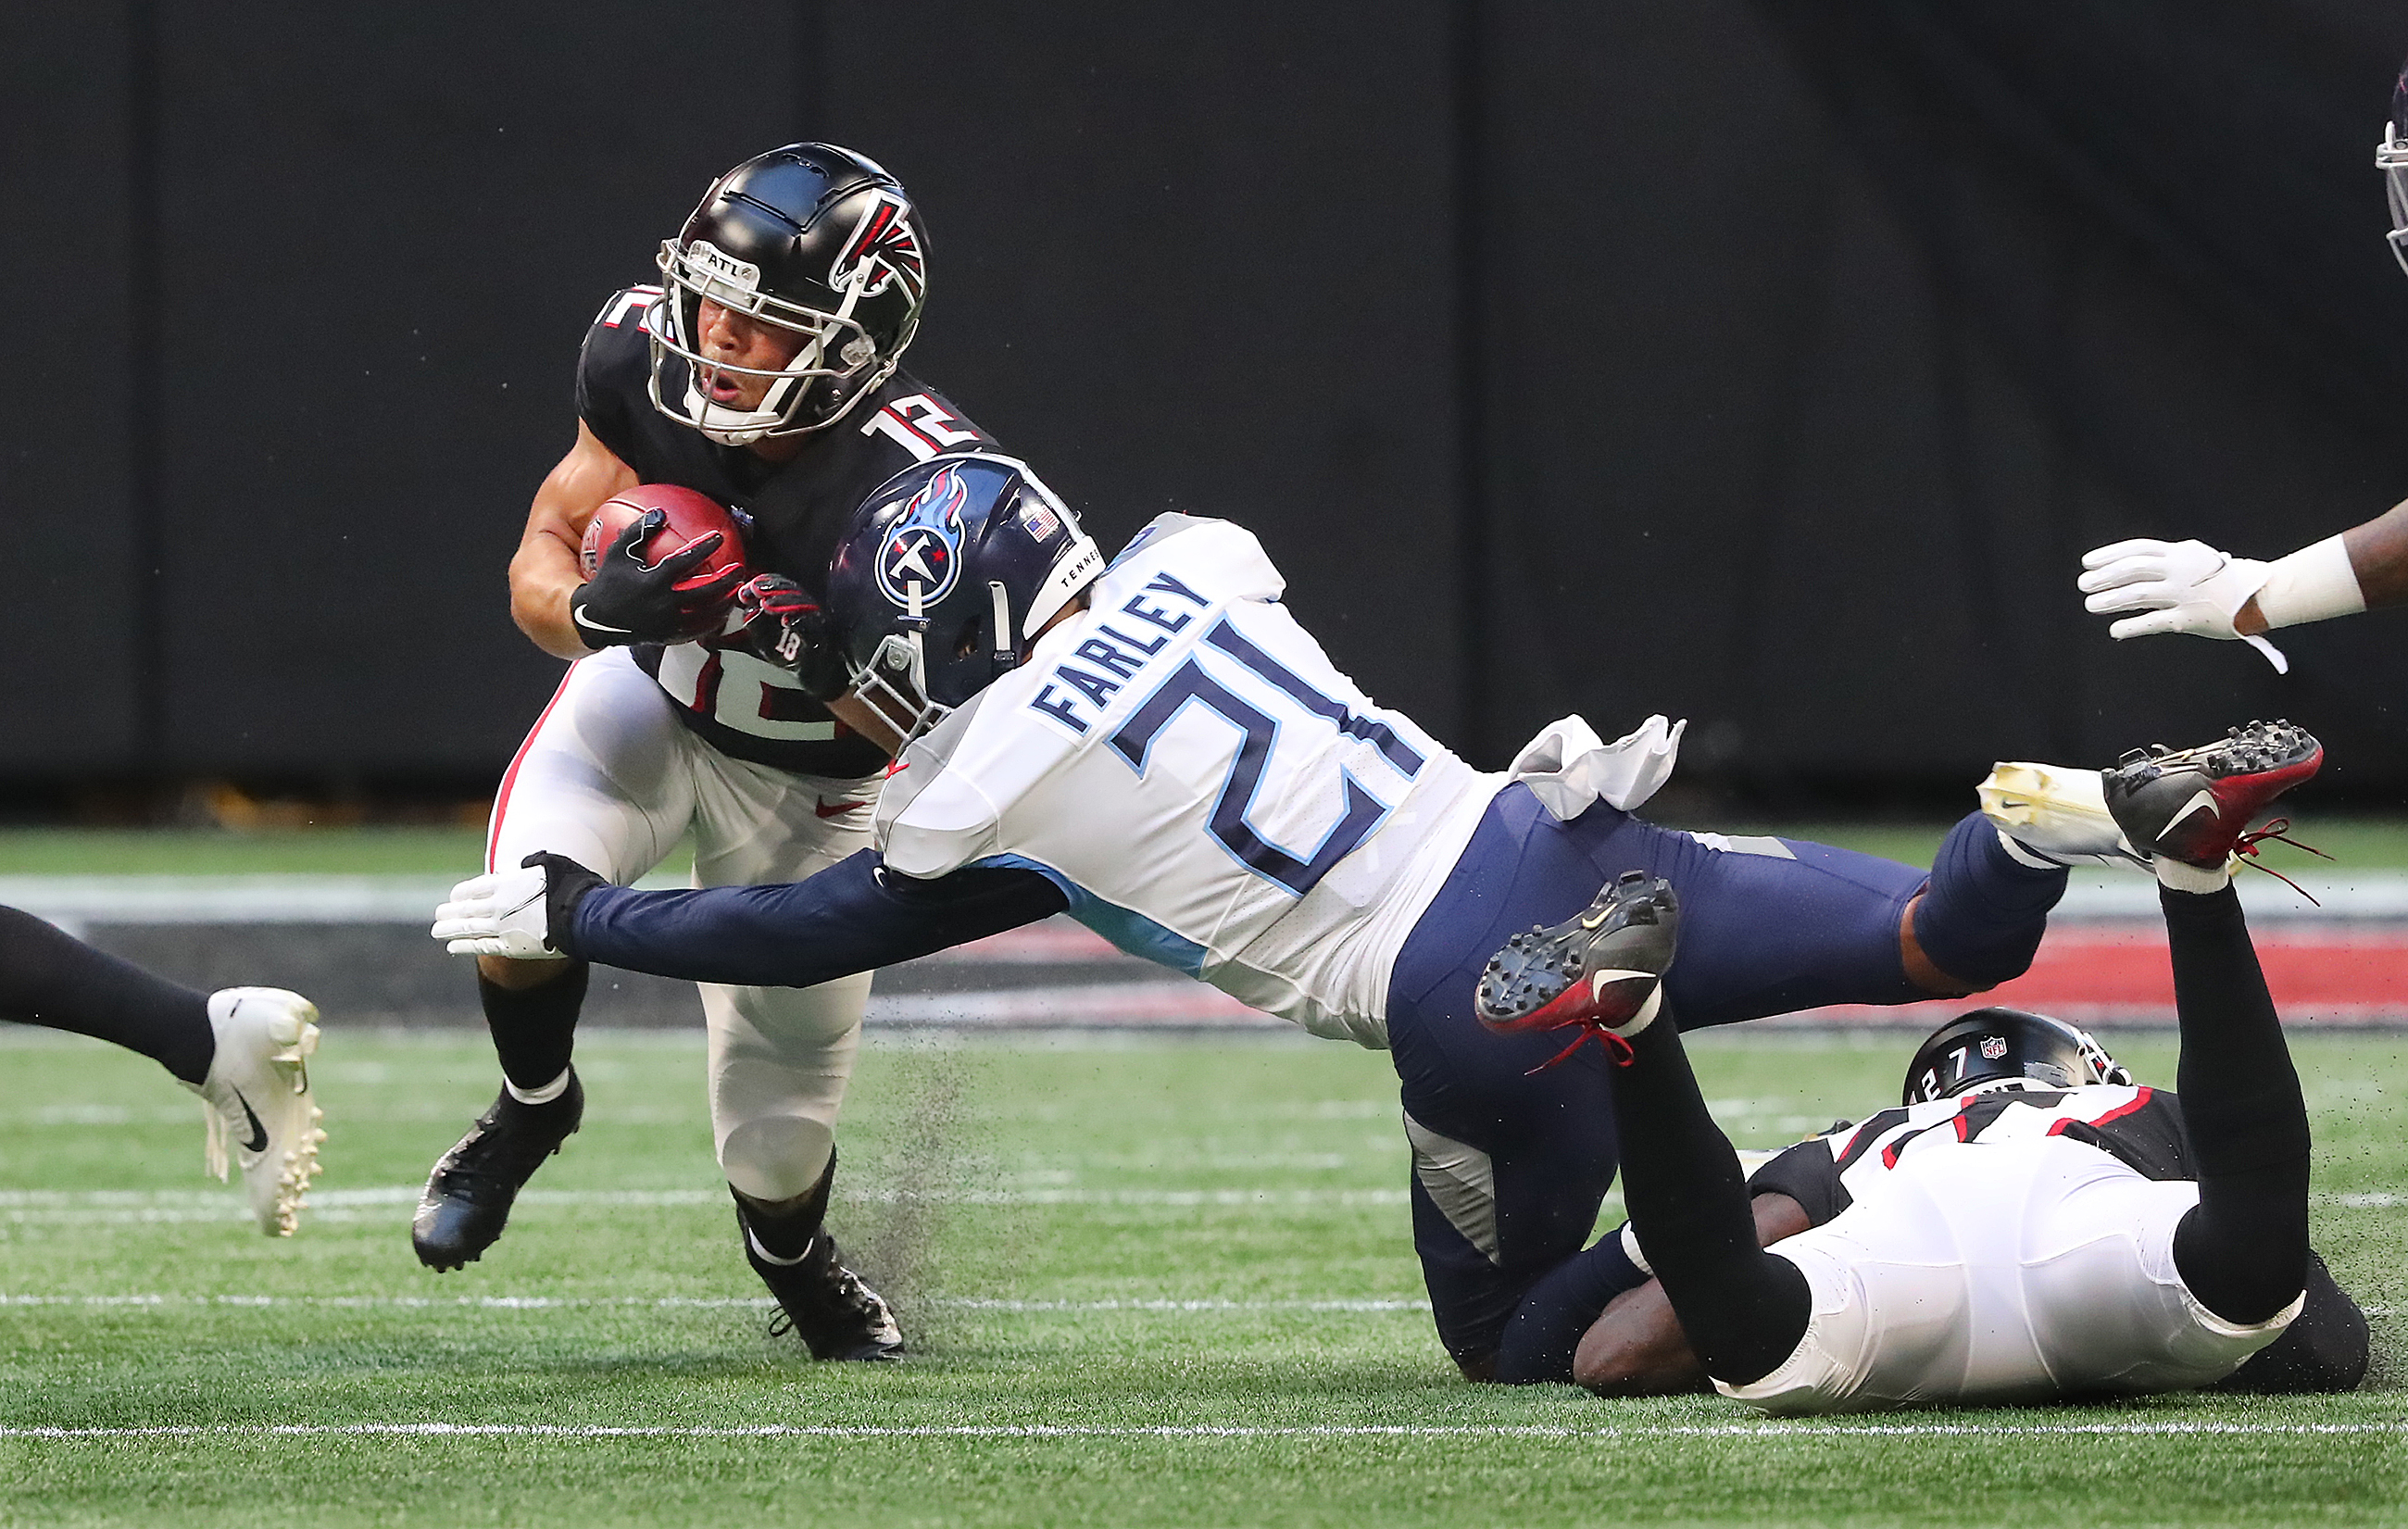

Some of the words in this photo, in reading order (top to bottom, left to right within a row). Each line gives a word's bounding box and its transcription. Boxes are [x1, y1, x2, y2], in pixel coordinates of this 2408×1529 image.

[708, 253, 738, 276] ATL
[859, 393, 982, 462] 12
[1027, 570, 1213, 737] FARLEY
[1103, 608, 1429, 898] 21
